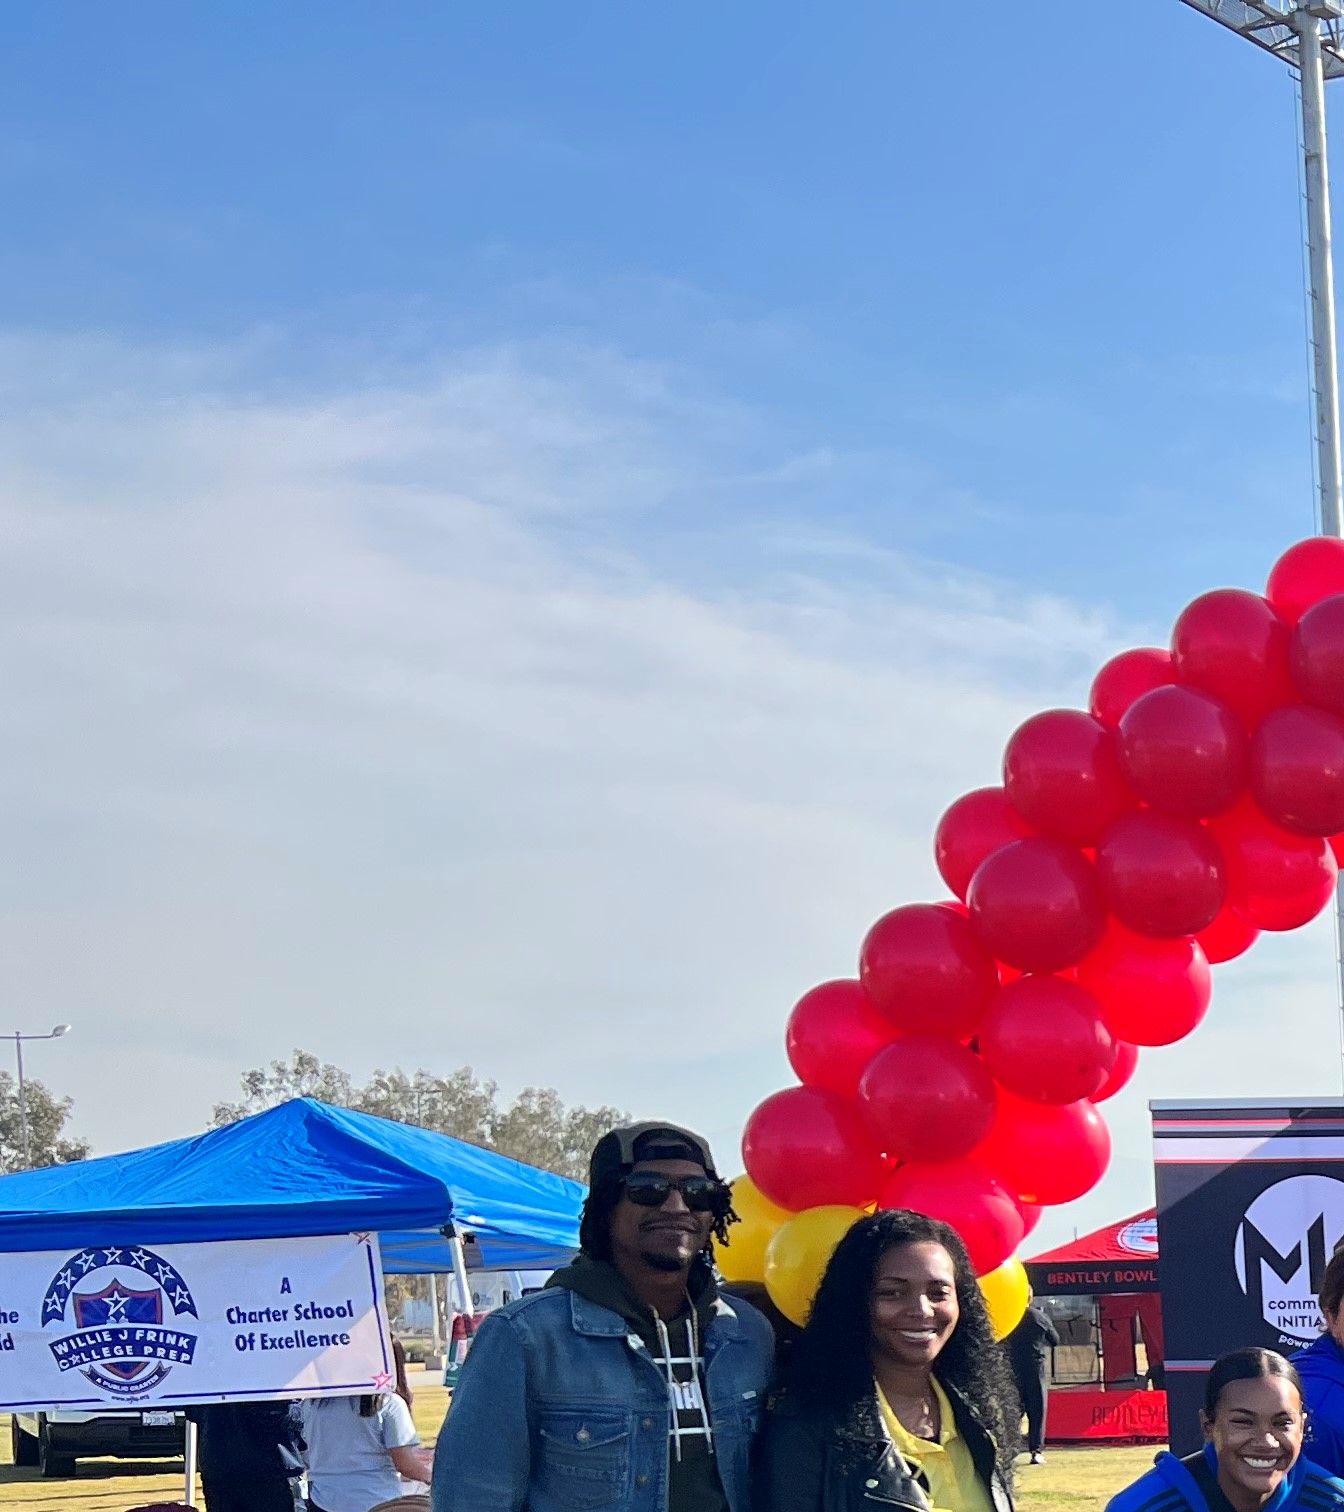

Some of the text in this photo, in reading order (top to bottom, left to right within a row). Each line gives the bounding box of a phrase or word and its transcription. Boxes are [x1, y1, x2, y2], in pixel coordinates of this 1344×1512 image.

[280, 1277, 292, 1295] A
[1047, 1269, 1158, 1285] BENTLEY BOWL
[226, 1300, 354, 1325] Charter School
[53, 1329, 191, 1357] WILLIE J FRINK
[235, 1330, 351, 1351] Of Excellence
[143, 1345, 191, 1363] PREP
